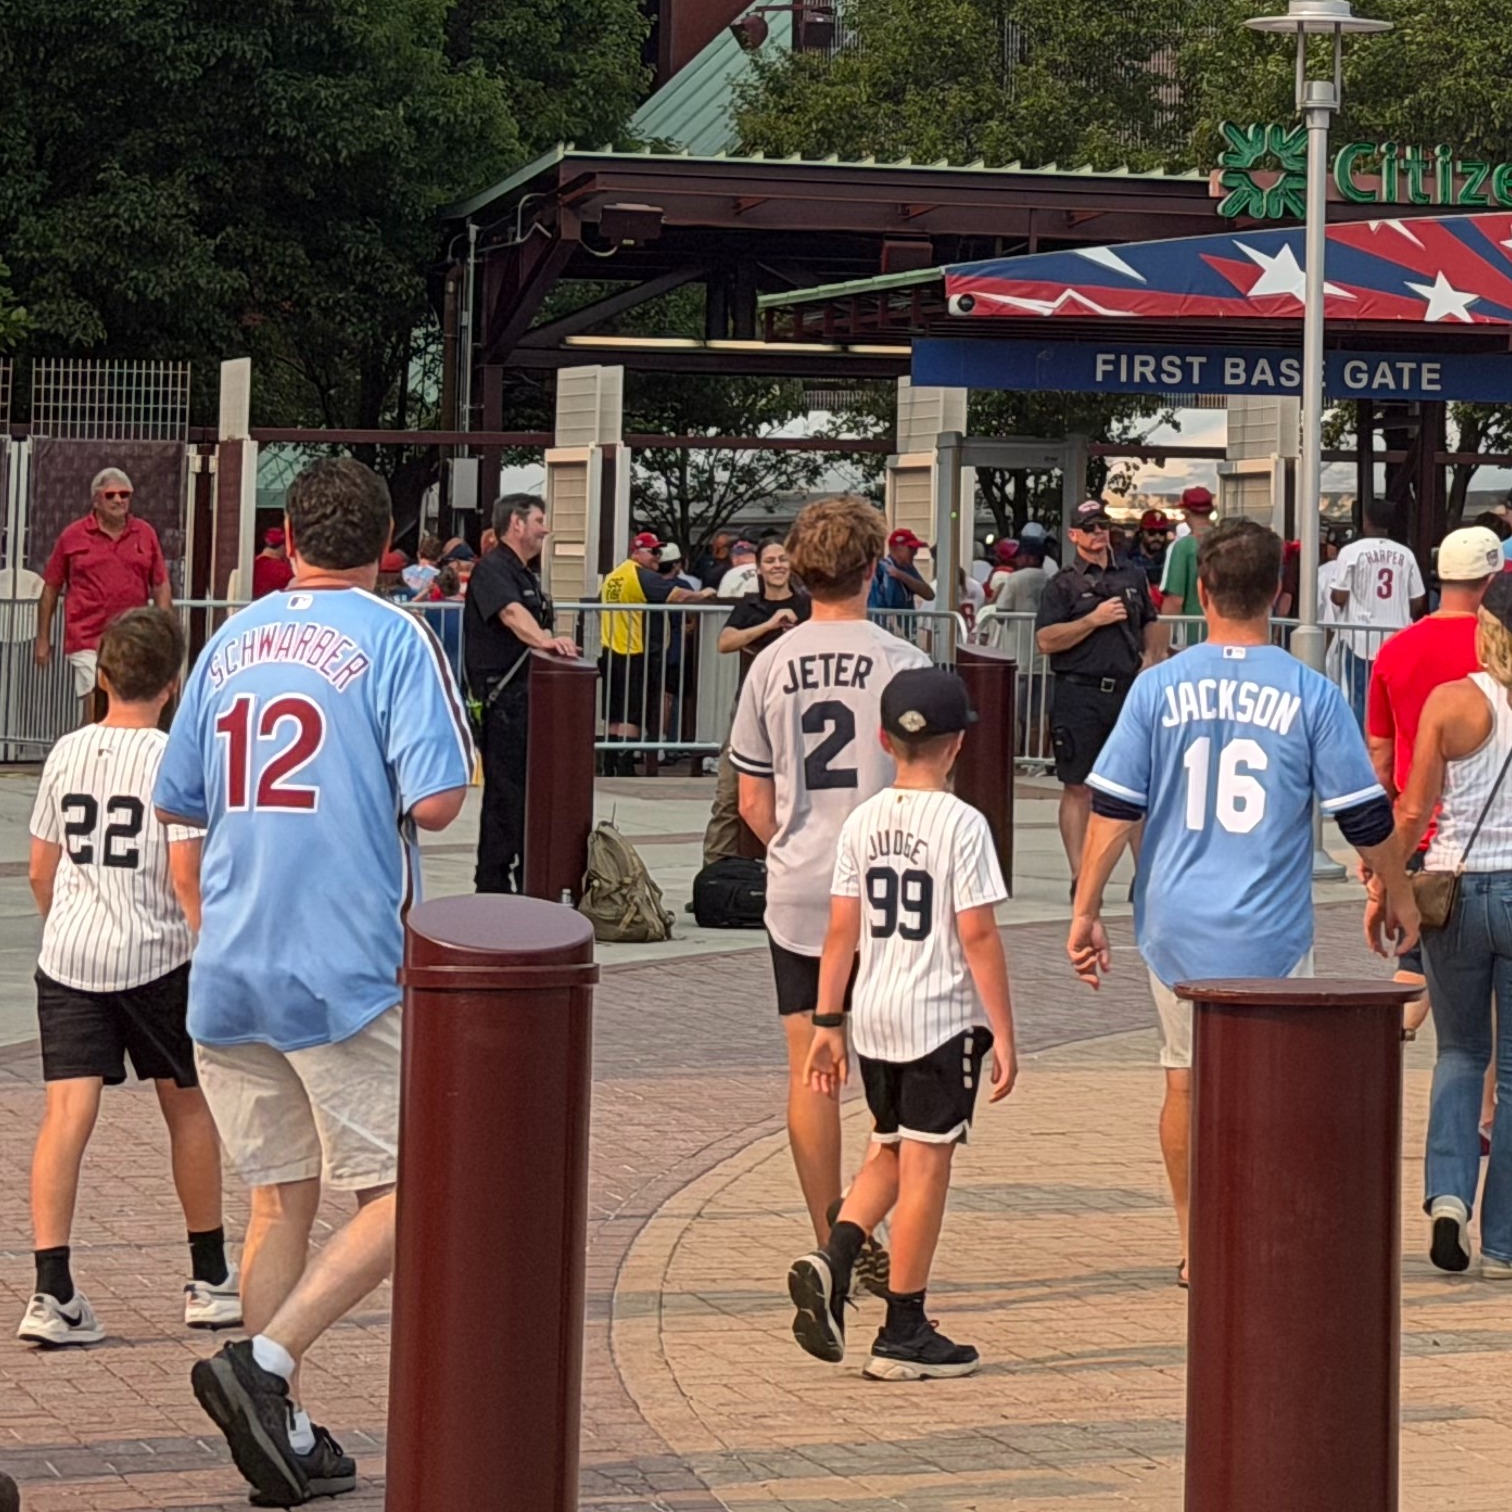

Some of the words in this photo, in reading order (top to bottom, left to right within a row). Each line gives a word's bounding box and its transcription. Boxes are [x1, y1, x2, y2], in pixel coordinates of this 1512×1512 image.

[1095, 352, 1207, 386] FIRST
[1224, 356, 1326, 388] BAS
[1343, 359, 1442, 391] GATE
[1376, 567, 1394, 600] 3
[209, 622, 371, 694] SCHWARBER
[782, 652, 874, 695] JETER
[1161, 678, 1302, 736] JACKSON
[215, 692, 327, 813] 12
[801, 699, 859, 791] 2
[1183, 736, 1268, 834] 16
[60, 793, 145, 870] 22
[868, 828, 929, 866] JUDGE
[865, 866, 934, 942] 99
